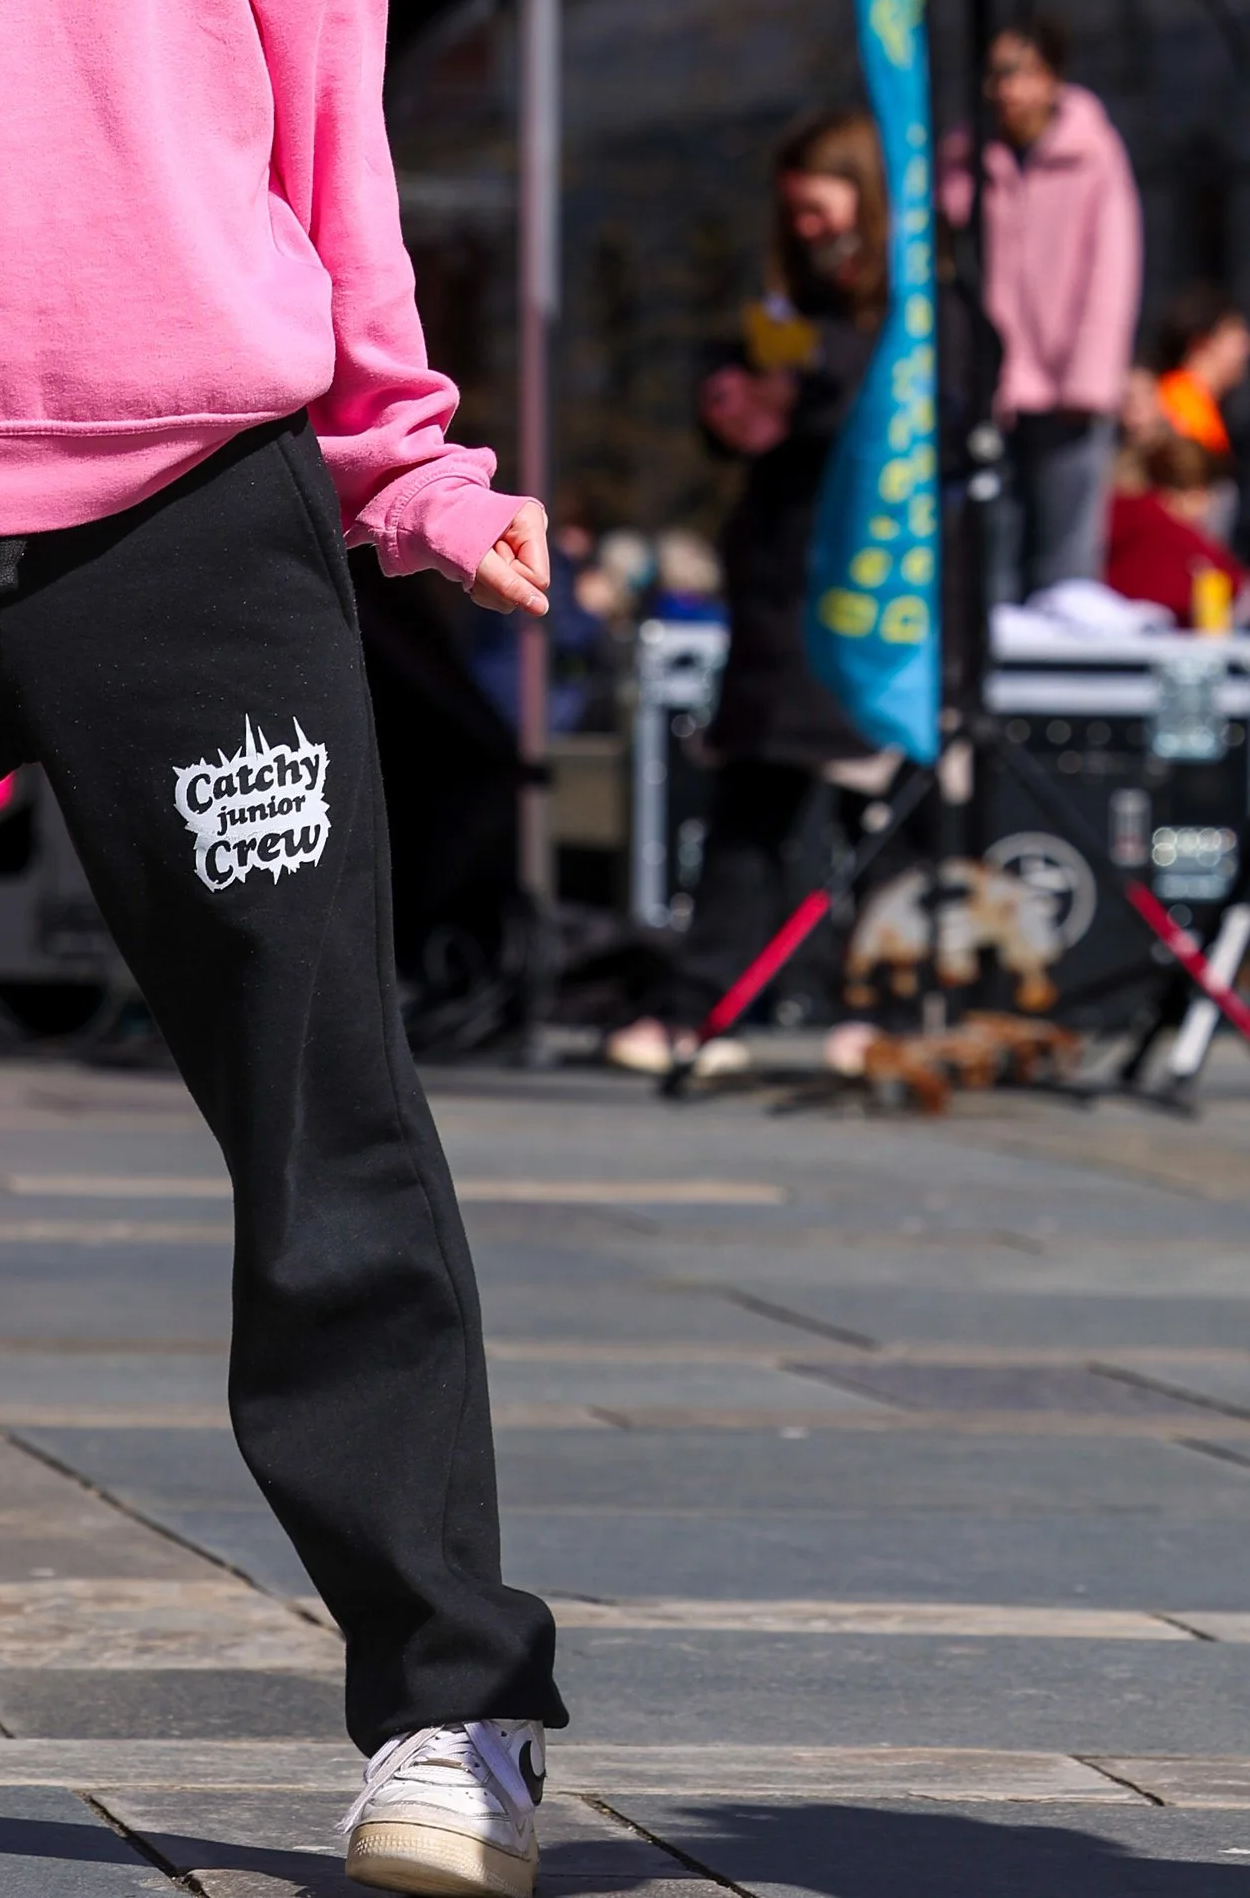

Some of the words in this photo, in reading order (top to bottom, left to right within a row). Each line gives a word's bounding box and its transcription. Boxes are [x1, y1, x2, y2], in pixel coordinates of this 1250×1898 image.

[186, 753, 320, 815] Catchy
[216, 794, 306, 837] junior
[204, 823, 321, 885] Crew
